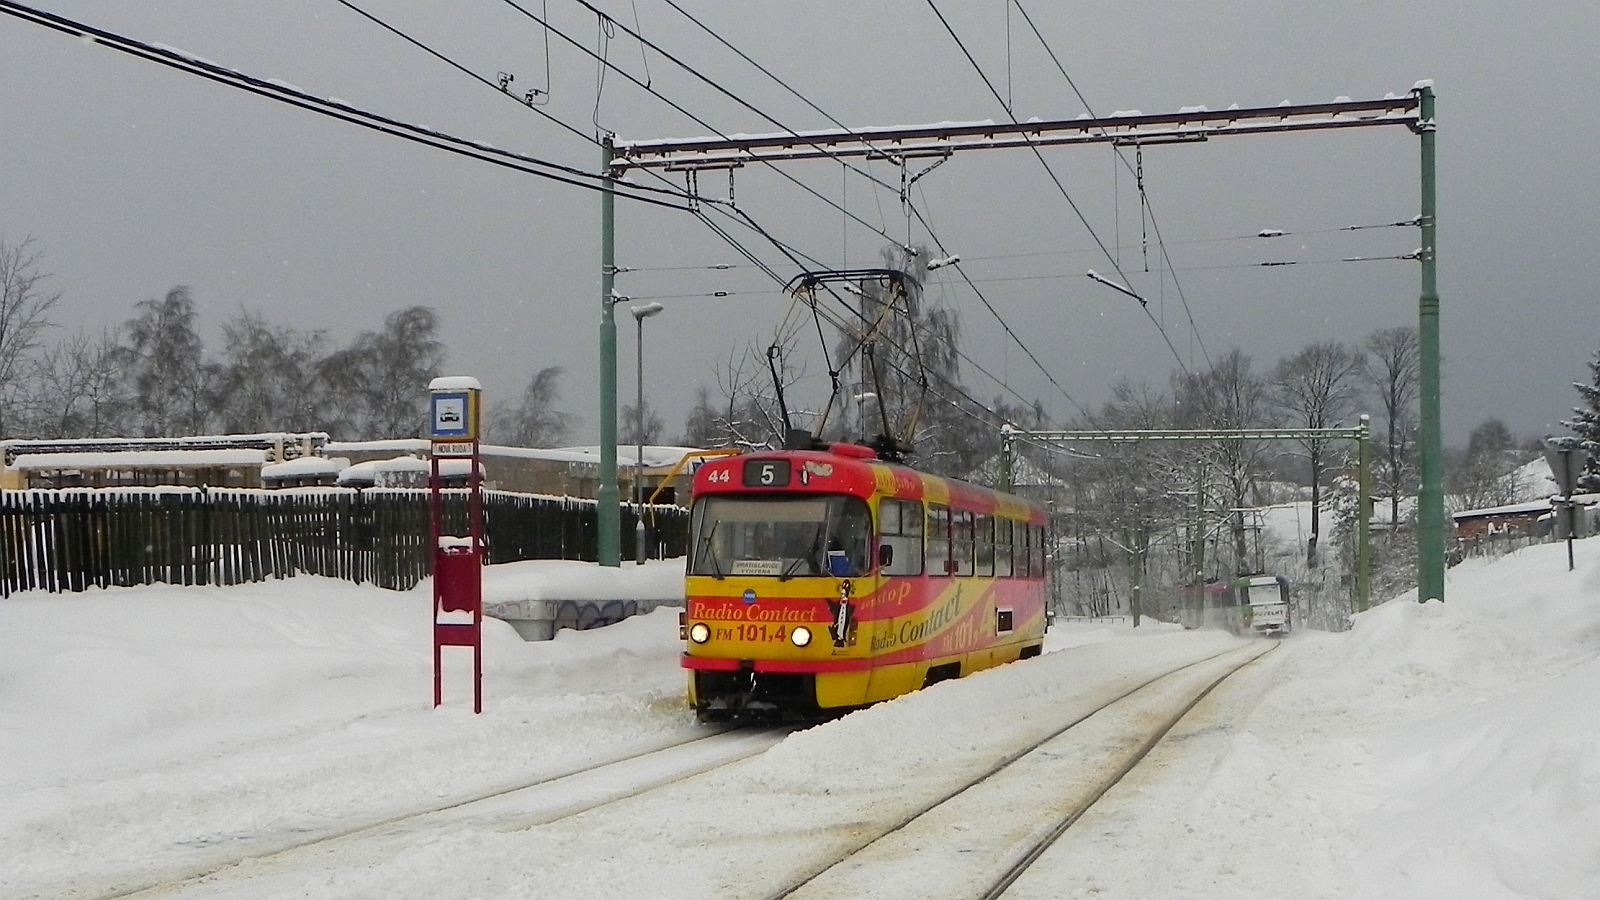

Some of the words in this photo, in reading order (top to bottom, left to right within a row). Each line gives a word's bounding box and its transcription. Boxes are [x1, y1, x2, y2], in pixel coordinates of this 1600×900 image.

[708, 469, 730, 484] 44
[760, 464, 775, 485] 5
[693, 602, 743, 621] Radio
[745, 604, 817, 622] Contact
[870, 631, 897, 652] Radio
[900, 583, 964, 645] Contact
[715, 628, 734, 642] FM
[736, 624, 787, 643] 101,4
